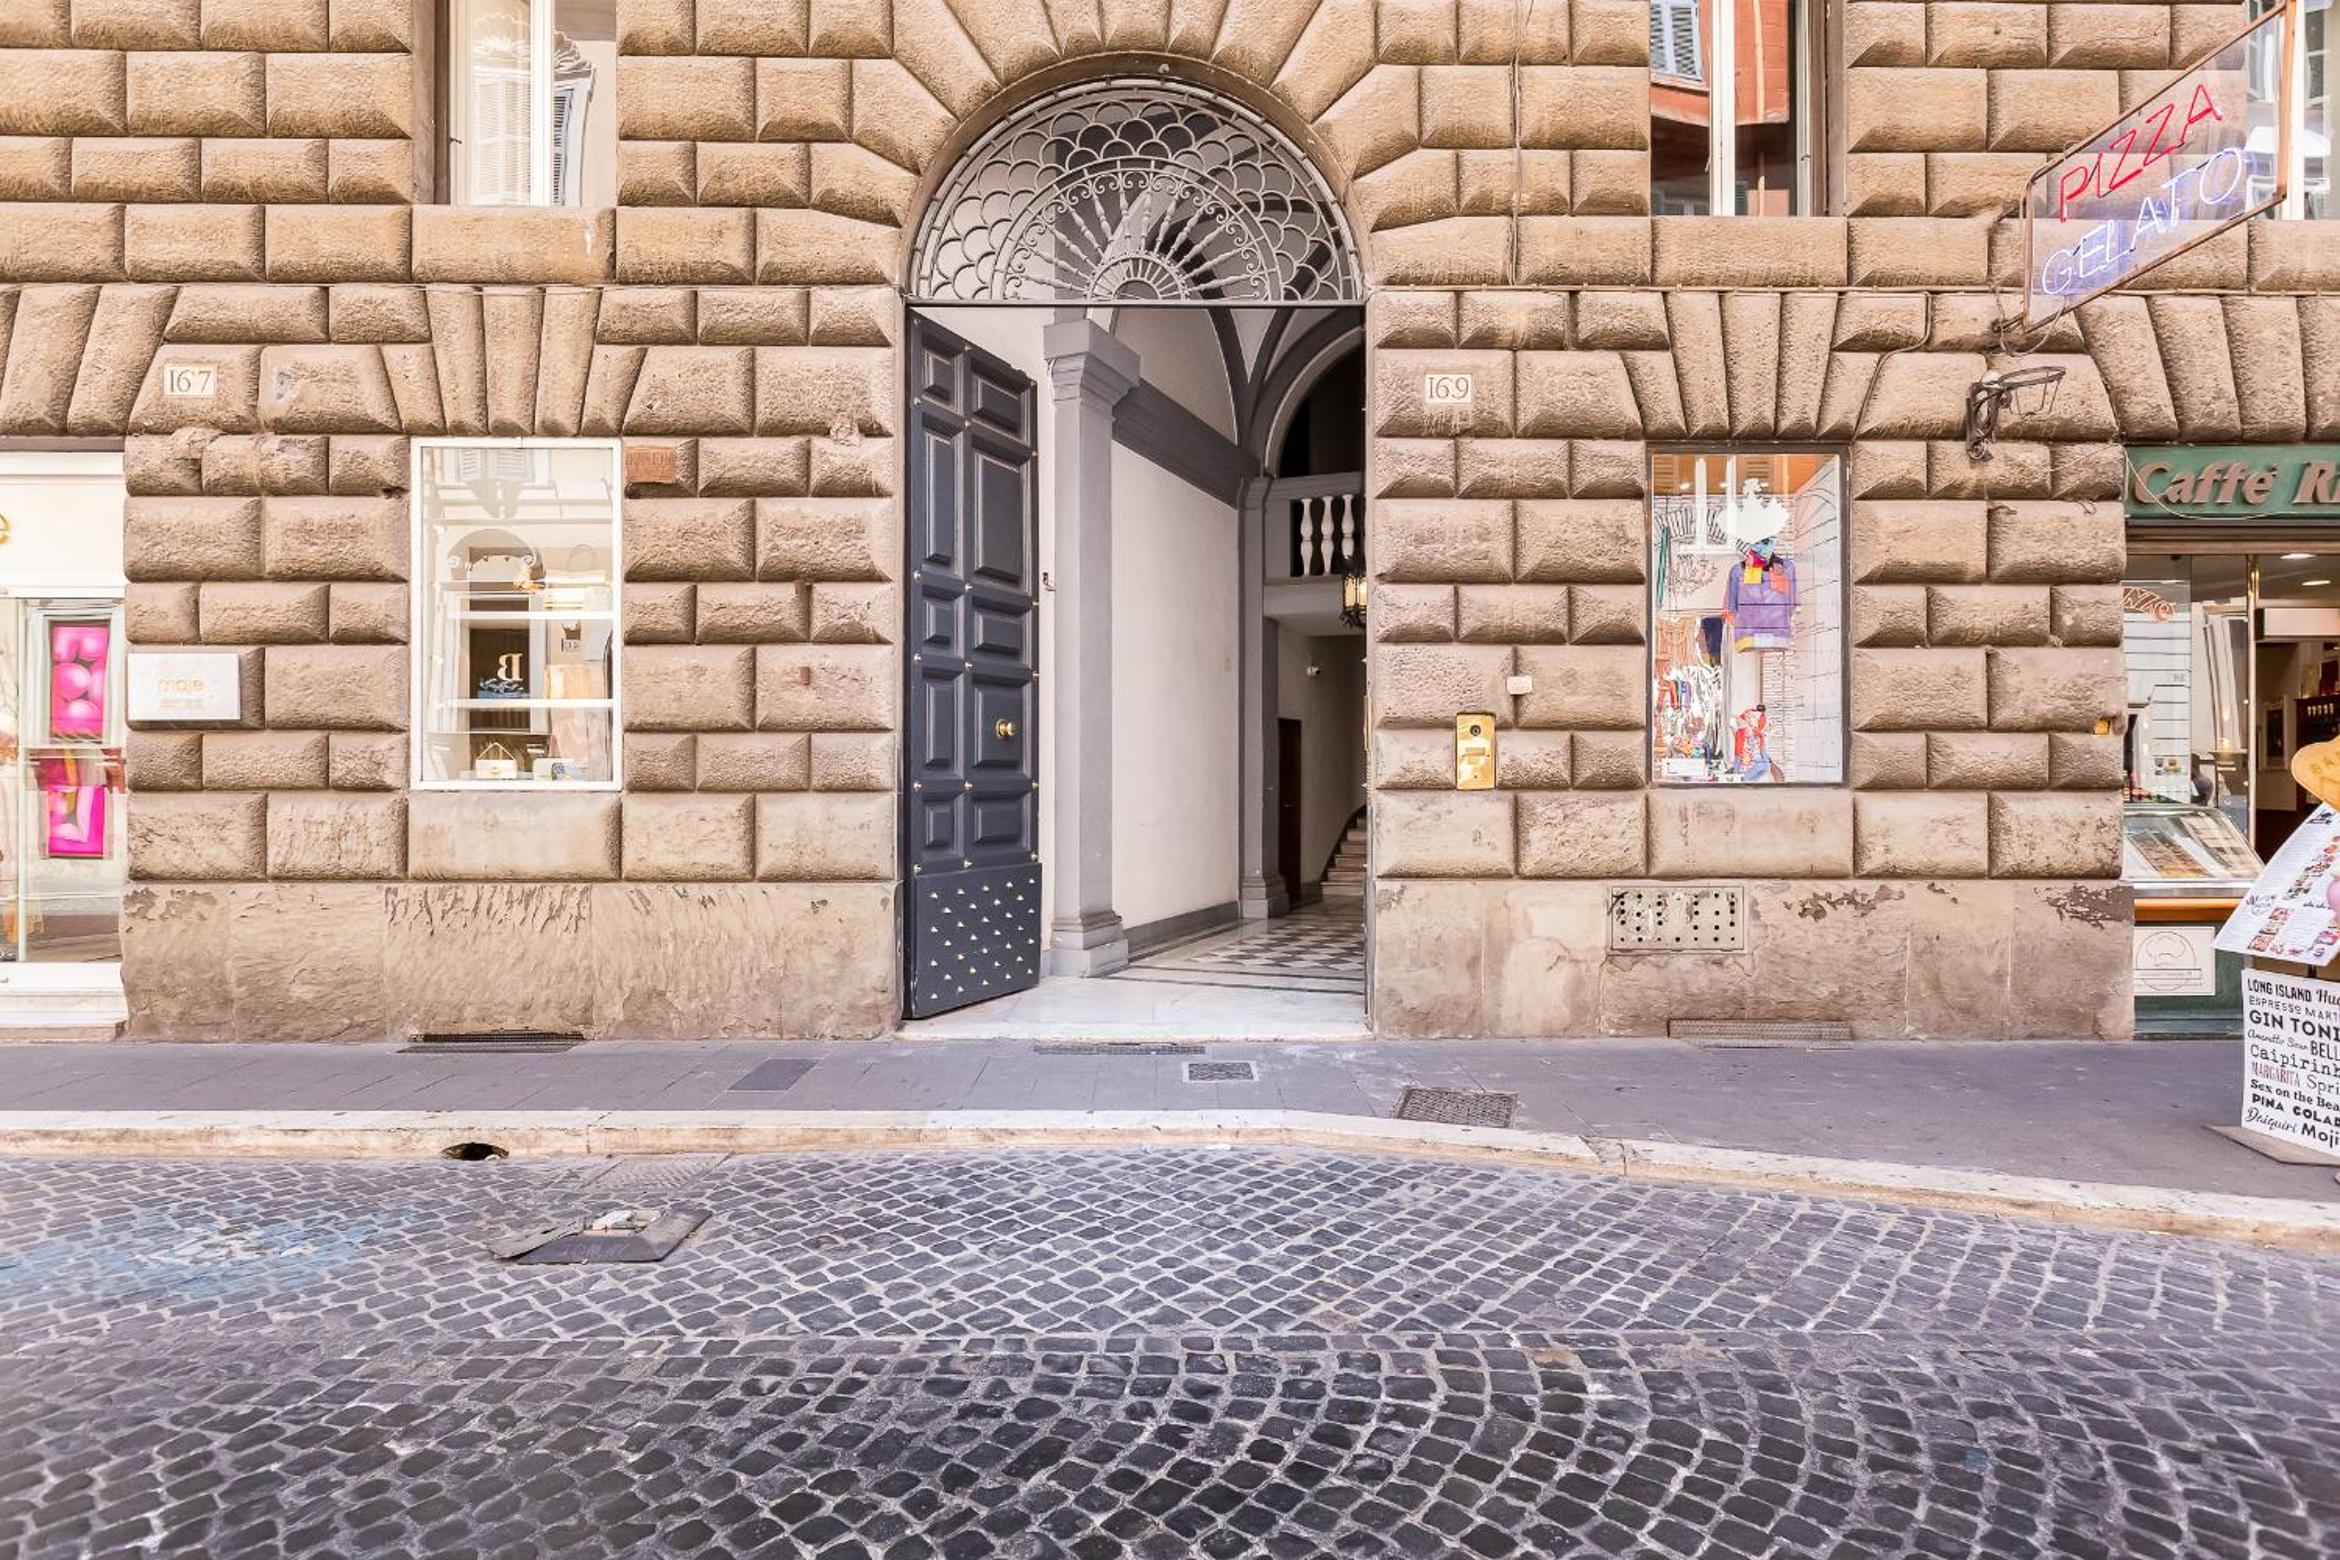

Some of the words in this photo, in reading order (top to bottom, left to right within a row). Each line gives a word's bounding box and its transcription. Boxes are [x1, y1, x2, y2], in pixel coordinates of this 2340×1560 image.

[2059, 83, 2223, 223] PIZZA
[2042, 147, 2243, 295] GELATO
[169, 368, 212, 394] 167
[1428, 376, 1470, 400] 169
[2247, 978, 2273, 995] LONG
[2275, 983, 2312, 1003] ISLAND
[2249, 995, 2302, 1015] ESPRESSO
[2249, 1009, 2284, 1030] GIN
[2250, 1078, 2273, 1094] Sex
[2275, 1087, 2291, 1099] on
[2293, 1091, 2314, 1105] the
